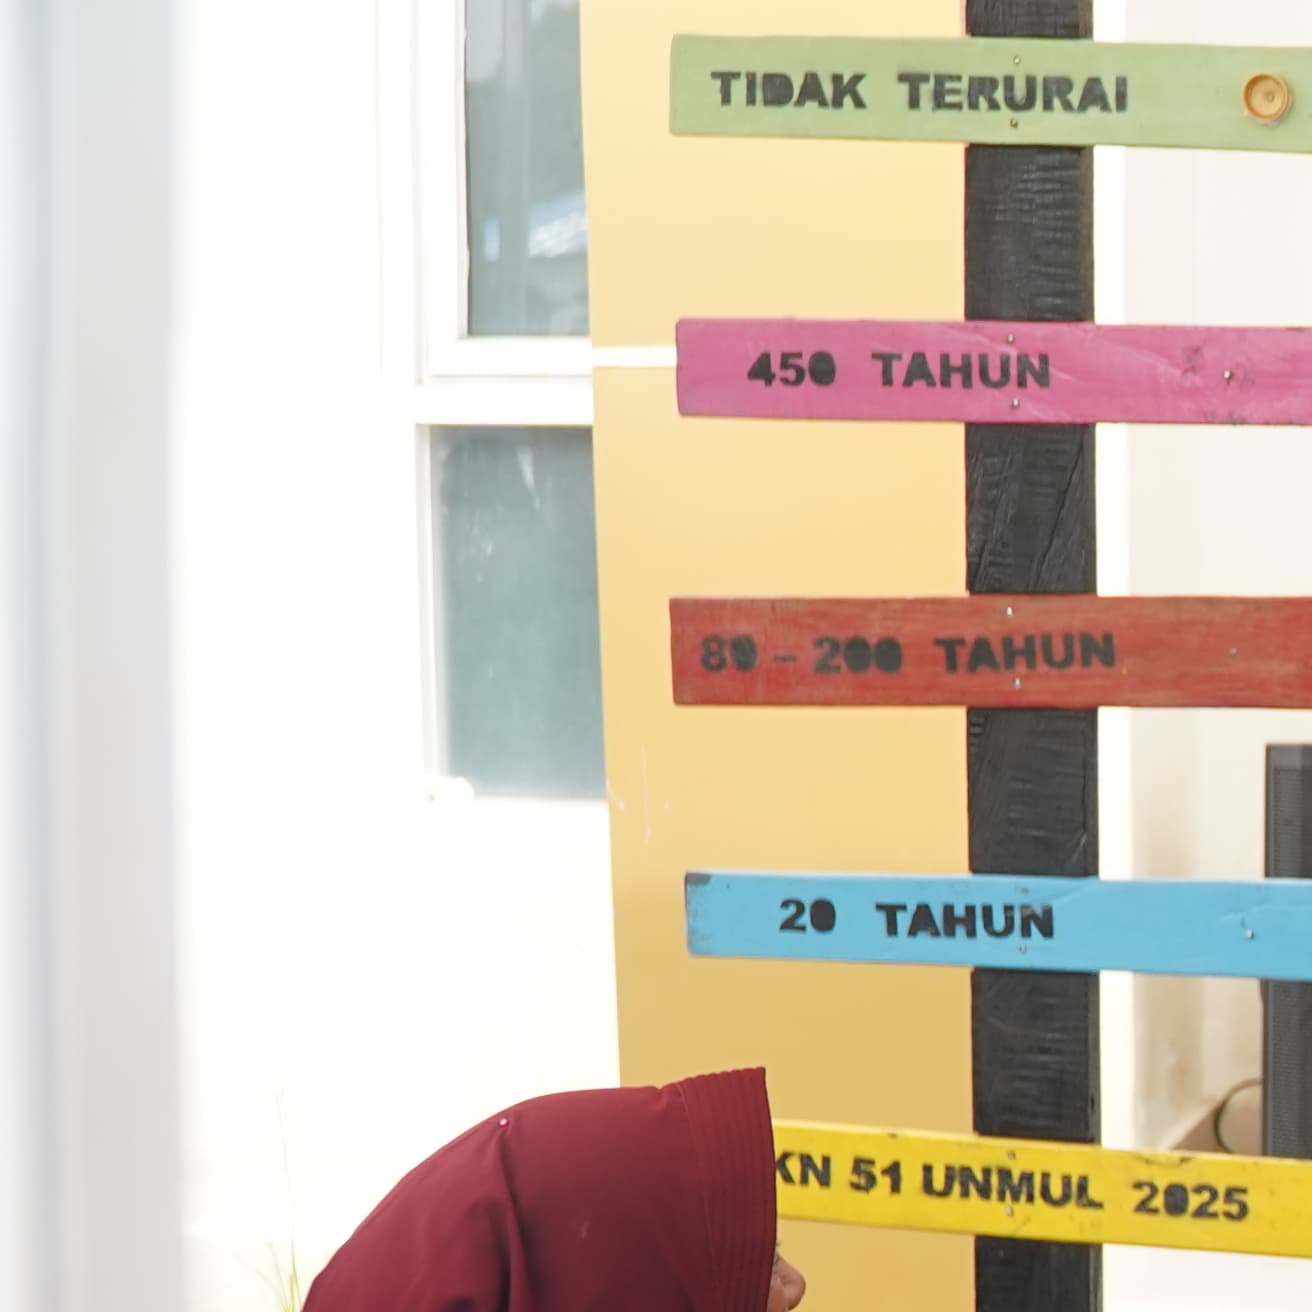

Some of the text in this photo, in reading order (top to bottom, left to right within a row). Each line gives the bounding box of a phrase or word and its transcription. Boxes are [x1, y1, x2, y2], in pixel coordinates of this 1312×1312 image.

[711, 71, 1128, 113] TIDAK TERURAI
[747, 351, 1051, 390] 450 TAHUN
[701, 634, 758, 673] 80
[814, 635, 904, 674] 200
[934, 632, 1116, 674] TAHUN
[779, 898, 1054, 939] 20 TAHUN
[850, 1156, 903, 1195] 51
[921, 1162, 1104, 1210] UNMUL
[1131, 1180, 1250, 1221] 2025
